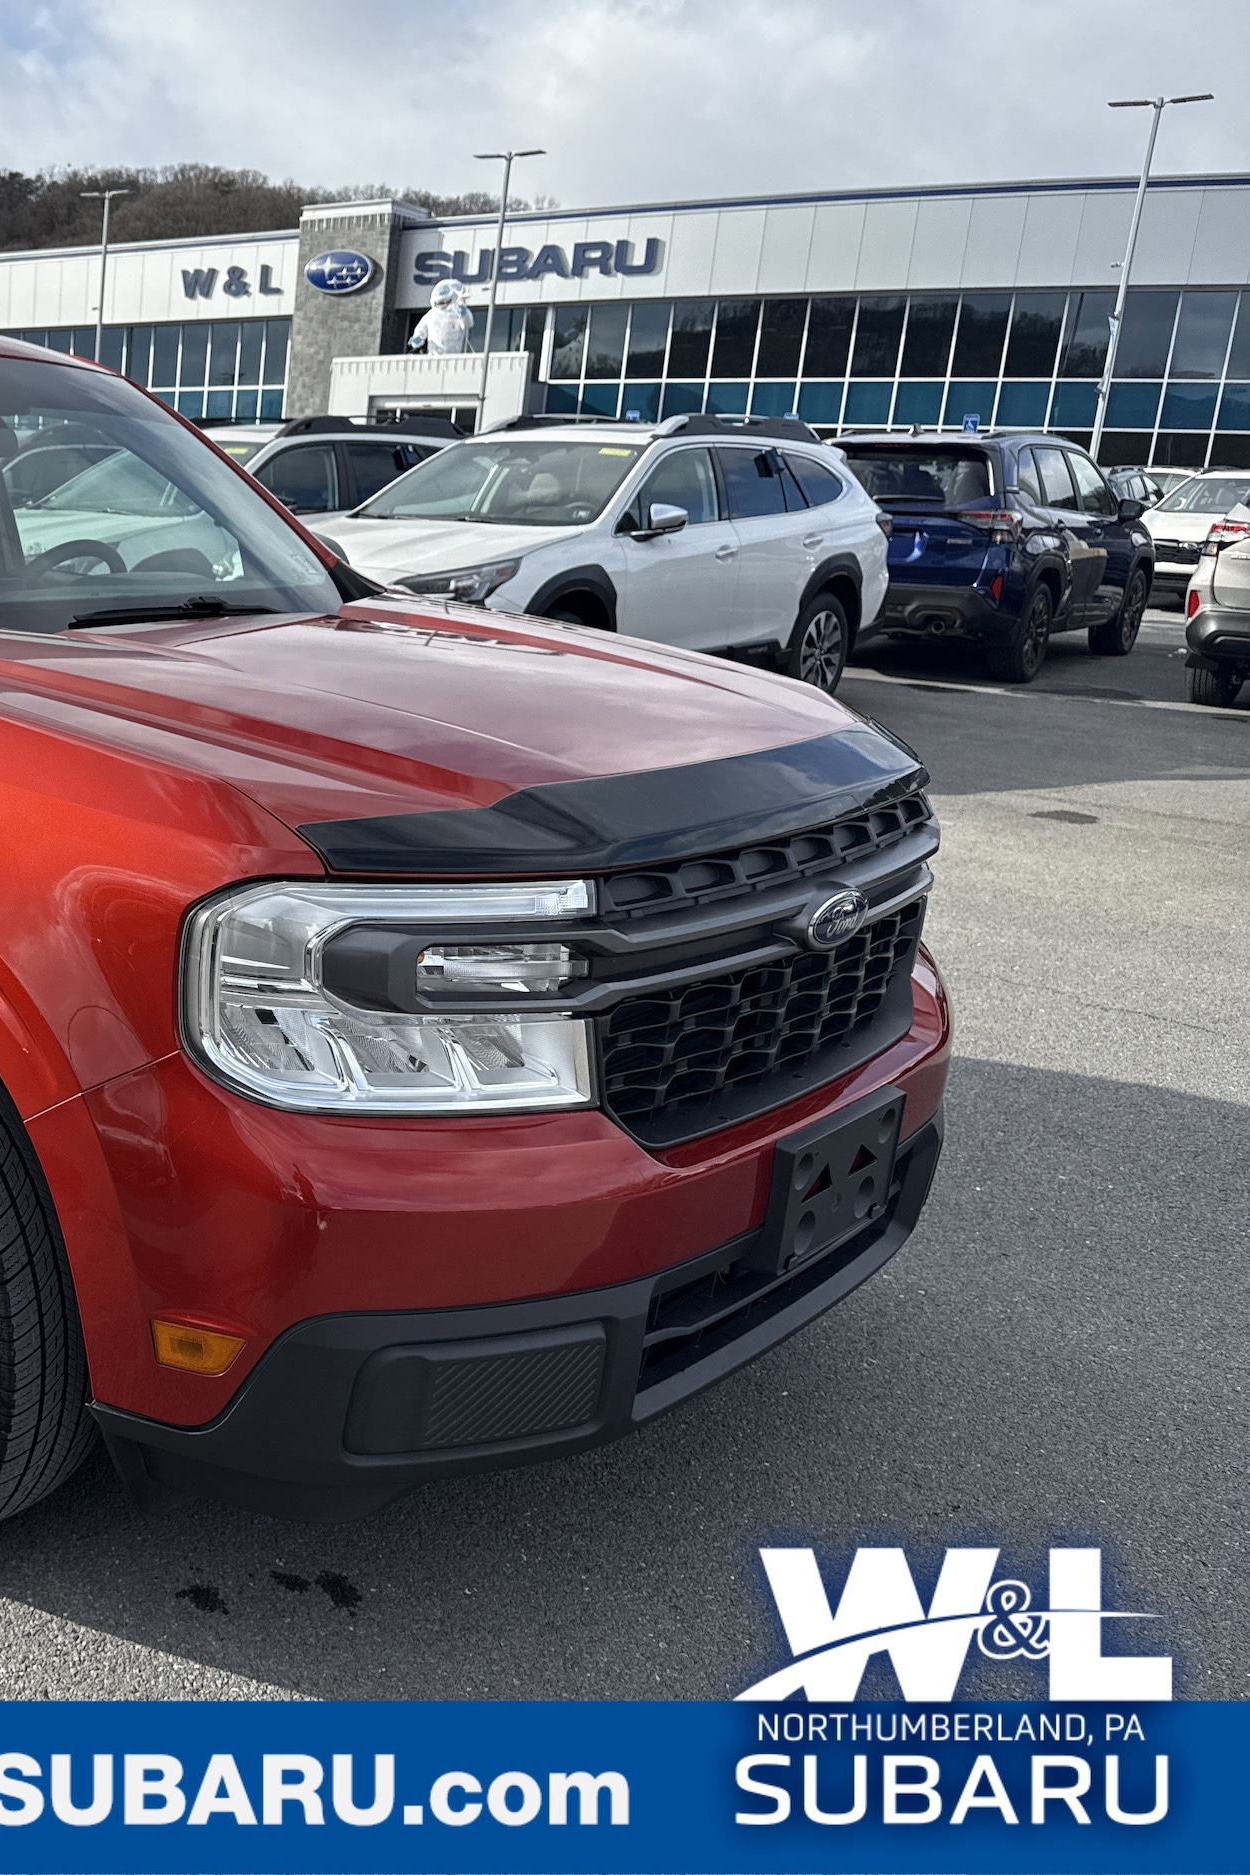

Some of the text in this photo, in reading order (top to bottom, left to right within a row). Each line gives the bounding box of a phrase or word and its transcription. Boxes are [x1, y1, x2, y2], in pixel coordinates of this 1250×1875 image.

[181, 264, 284, 300] W & L
[414, 238, 664, 285] SUBARU
